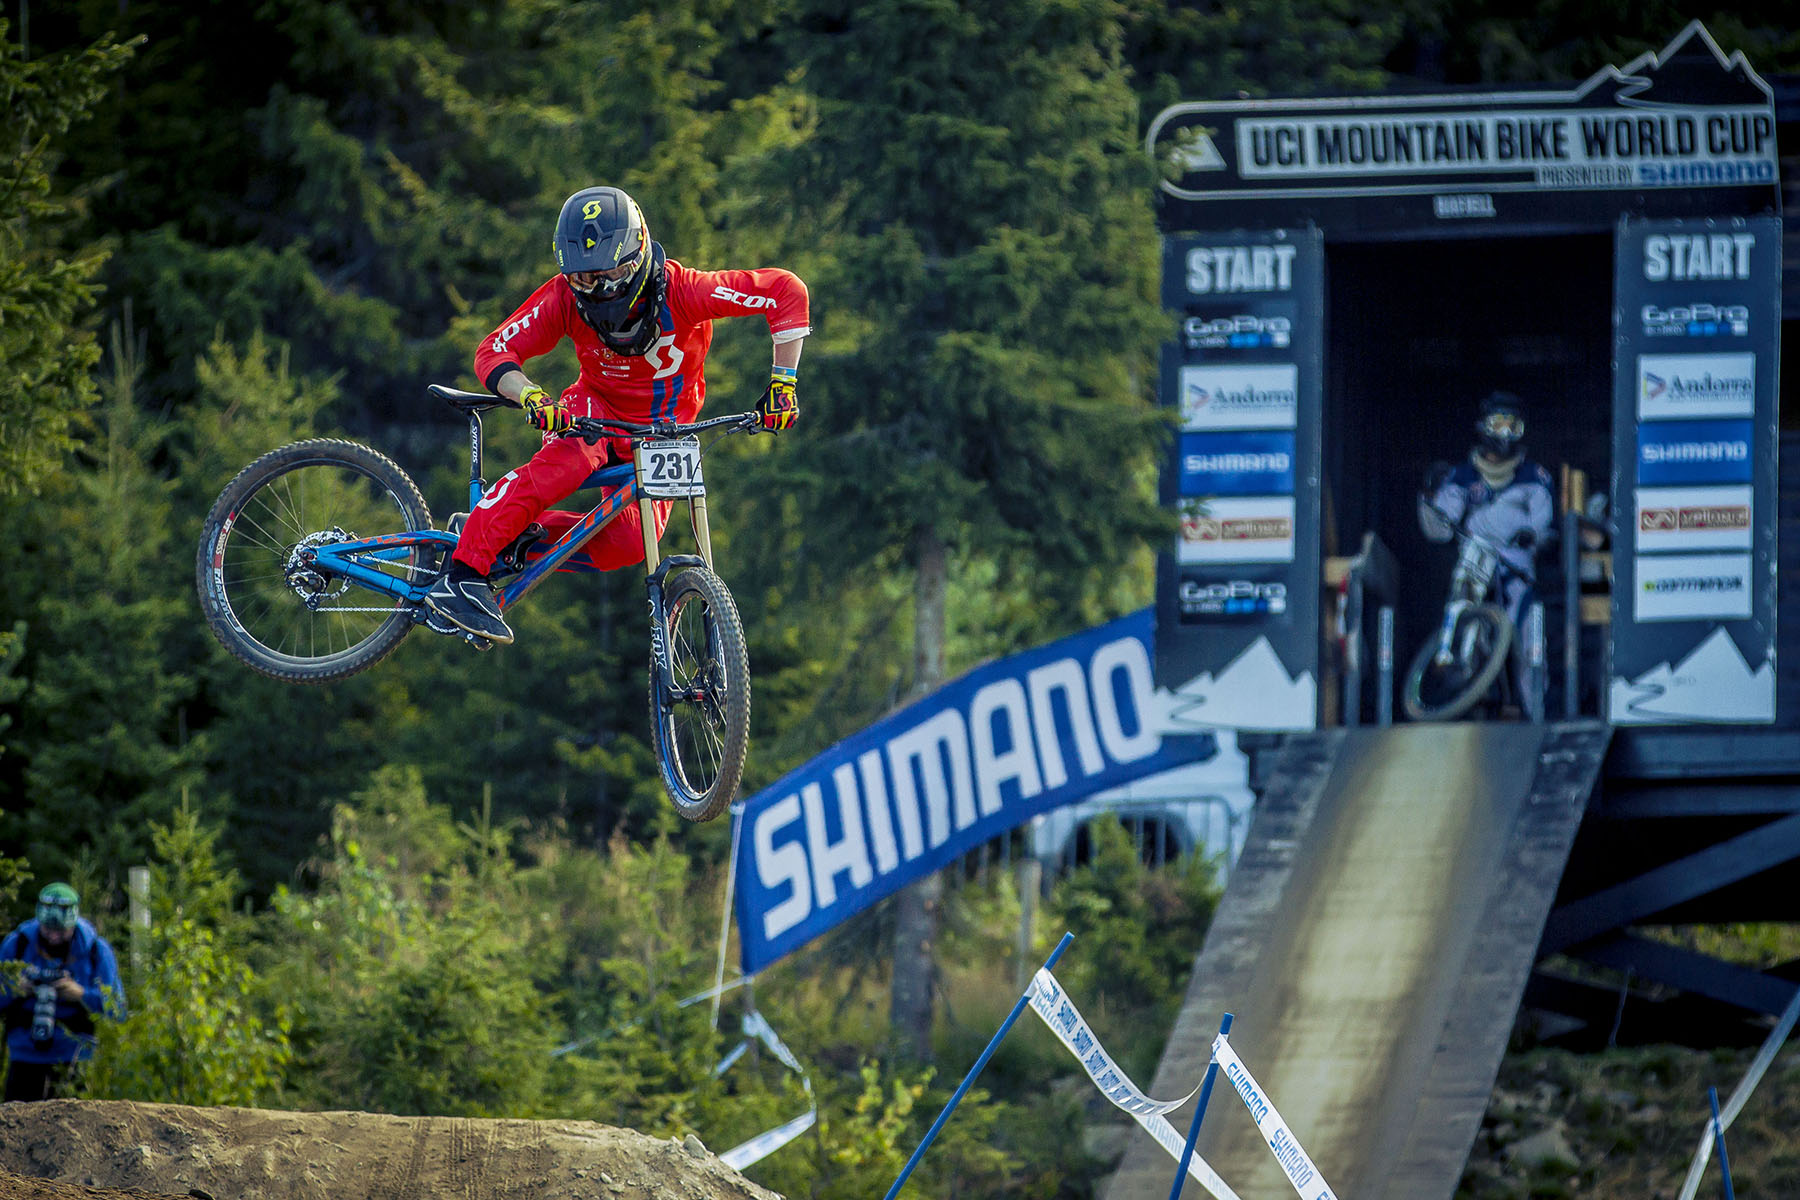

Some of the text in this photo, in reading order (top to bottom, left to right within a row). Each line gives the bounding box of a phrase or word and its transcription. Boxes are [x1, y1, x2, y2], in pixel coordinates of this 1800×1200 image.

[1252, 112, 1770, 167] UCI MOUNTAIN BIKE WORLD CUP
[1638, 160, 1774, 182] SHIMANO
[1186, 245, 1296, 294] START
[1643, 234, 1755, 281] START
[650, 452, 693, 480] 231
[1184, 453, 1290, 473] SHIMANO
[1641, 441, 1748, 463] SHIMANO
[1179, 580, 1287, 602] GoPro
[651, 626, 668, 671] FOX
[755, 636, 1162, 941] SHIMANO
[1269, 1127, 1314, 1189] SHIMANO
